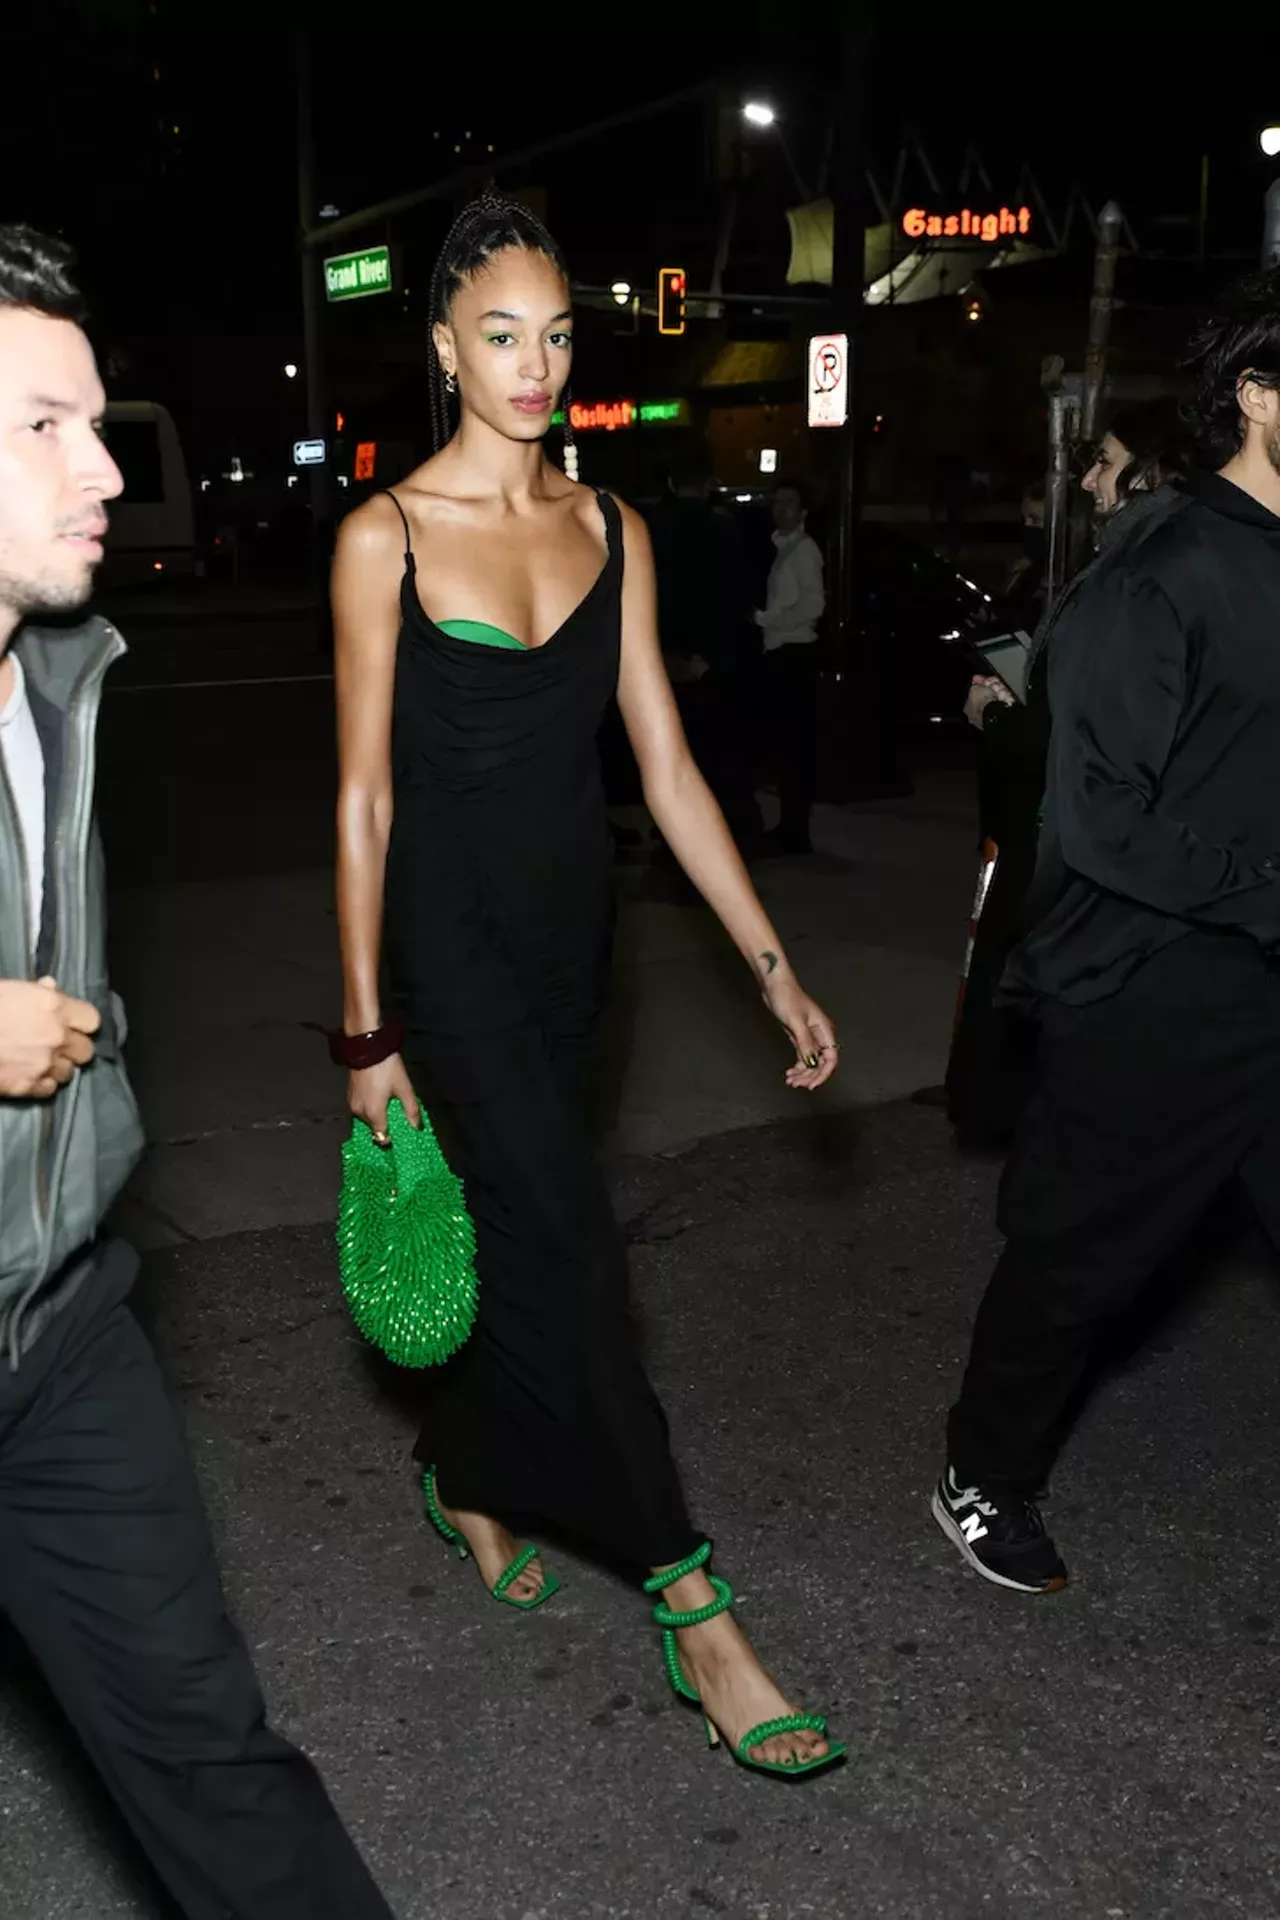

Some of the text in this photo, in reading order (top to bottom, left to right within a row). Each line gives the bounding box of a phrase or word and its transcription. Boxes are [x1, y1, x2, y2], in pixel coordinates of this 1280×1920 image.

[903, 207, 1030, 241] Gaslight
[327, 256, 387, 292] Grand River
[569, 401, 632, 430] Gaslight
[960, 1512, 988, 1543] N
